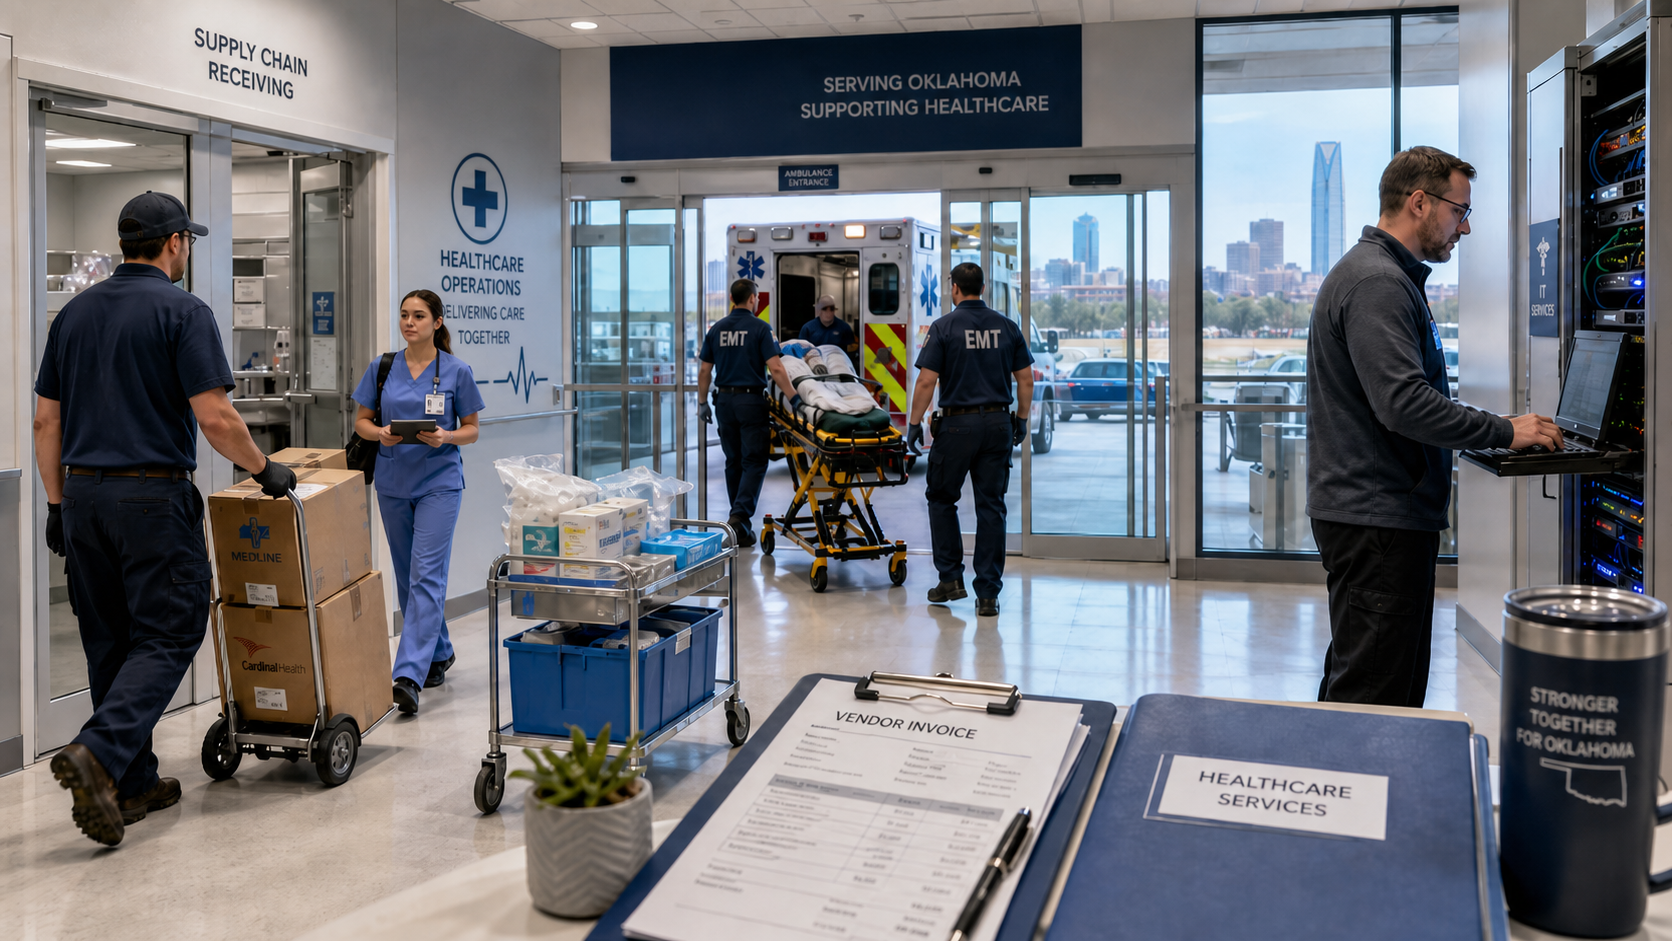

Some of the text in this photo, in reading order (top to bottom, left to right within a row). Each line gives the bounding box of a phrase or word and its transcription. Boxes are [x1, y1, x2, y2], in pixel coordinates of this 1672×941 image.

[194, 27, 307, 77] SUPPLY CHAIN
[208, 60, 294, 99] RECEIVING
[823, 71, 1021, 93] SERVING OKLAHOMA
[801, 95, 1049, 119] SUPPORTING HEALTHCARE
[788, 178, 829, 187] ENTRANCE
[440, 249, 524, 273] HEALTHCARE
[441, 275, 521, 296] OPERATIONS
[1539, 284, 1546, 299] IT
[500, 306, 525, 320] CARE
[1531, 304, 1554, 316] SERVICES
[458, 330, 510, 344] TOGETHER
[719, 330, 748, 347] EMT
[964, 329, 1001, 349] EMT
[231, 551, 282, 563] MEDLINE
[1530, 686, 1619, 713] STRONGER
[836, 711, 978, 740] VENDOR INVOICE
[1529, 708, 1617, 736] TOGETHER
[1516, 727, 1636, 759] FOR OKLAHOMA
[1199, 771, 1352, 799] HEALTHCARE
[1217, 793, 1327, 817] SERVICES
